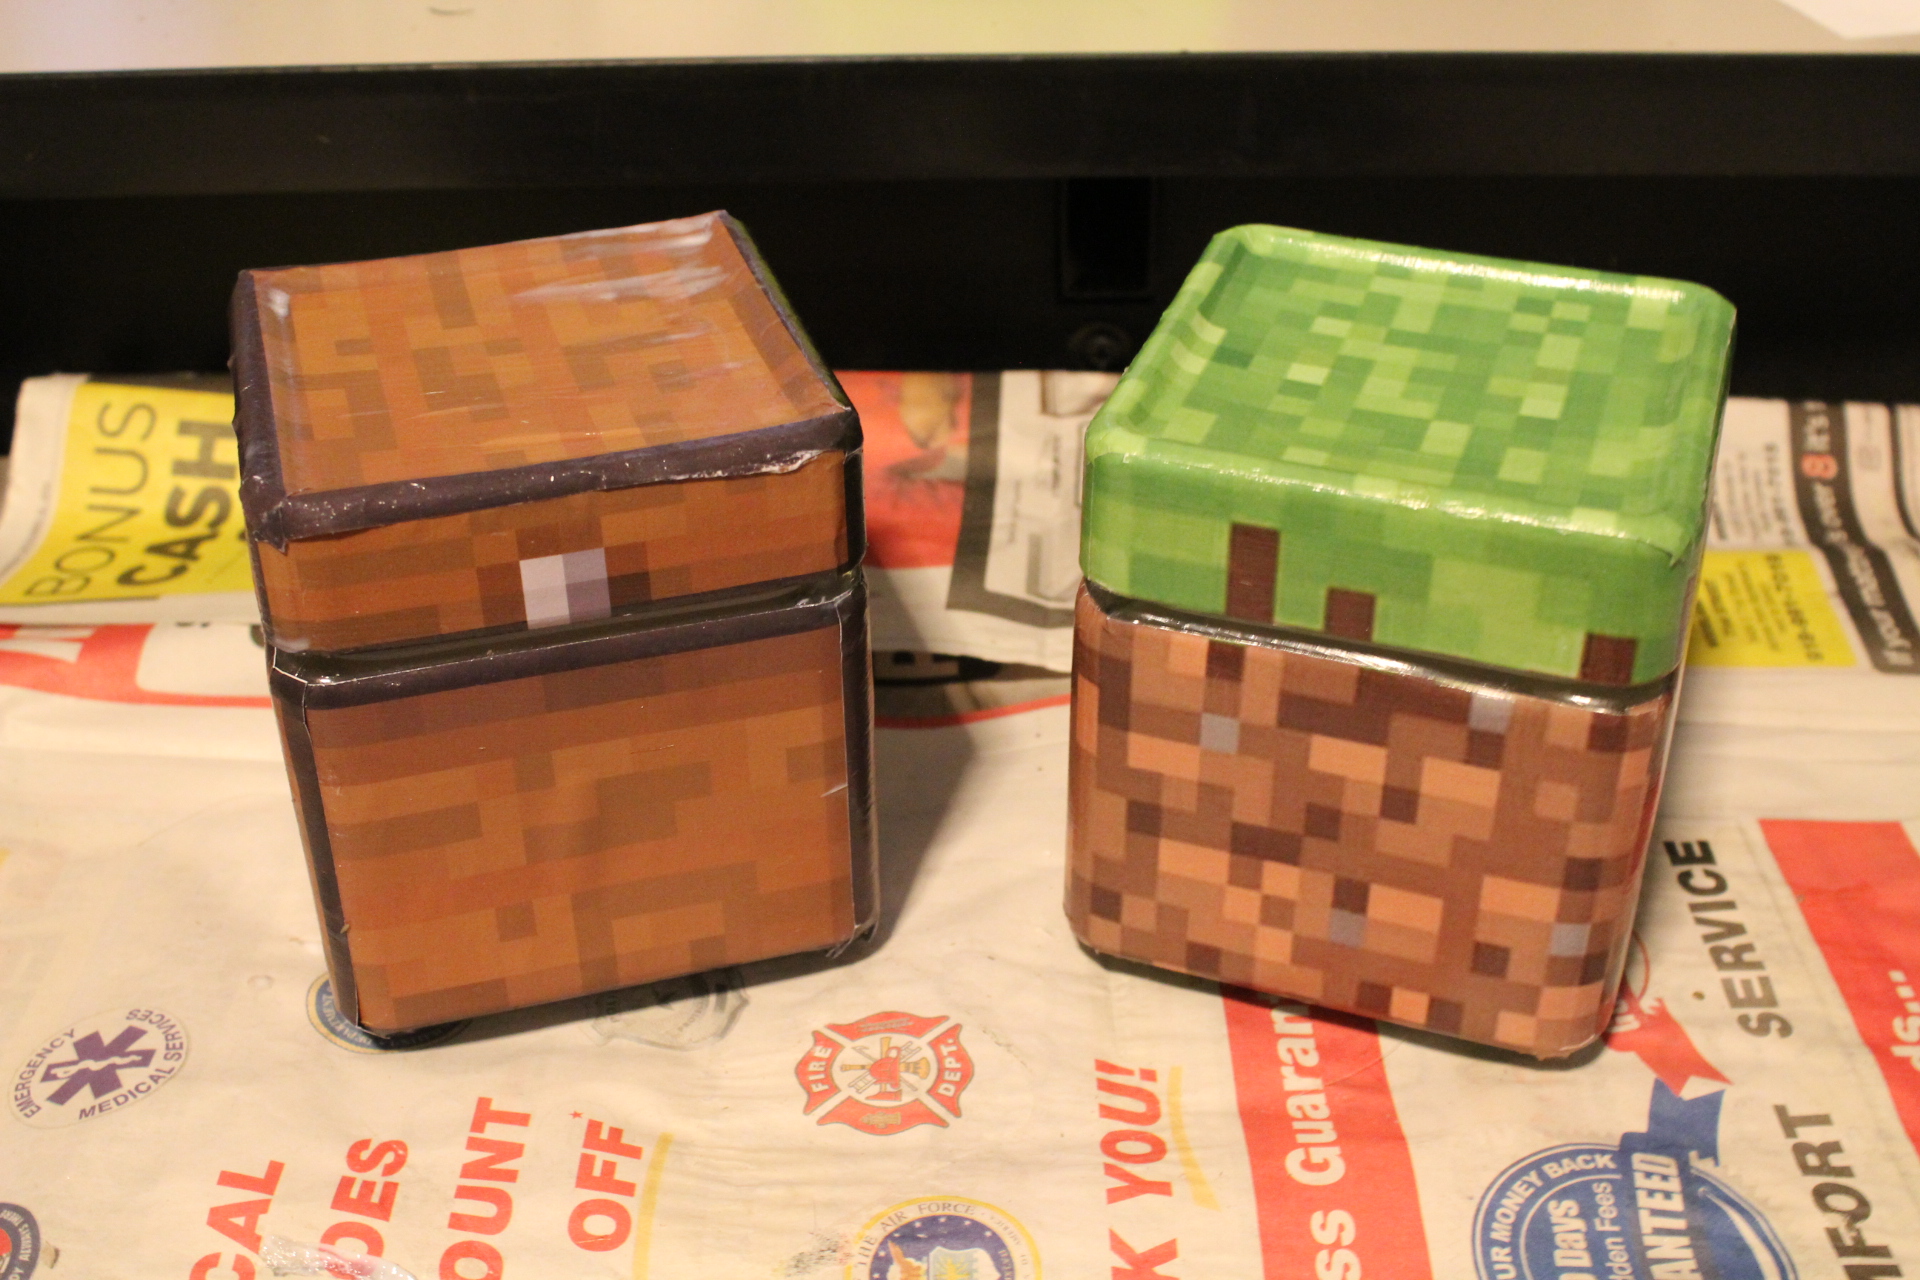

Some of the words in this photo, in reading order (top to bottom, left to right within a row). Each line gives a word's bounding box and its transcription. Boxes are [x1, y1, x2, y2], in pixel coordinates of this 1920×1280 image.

[24, 402, 157, 597] BONUS
[117, 418, 238, 586] CASH
[1662, 840, 1794, 1039] SERVICE
[14, 1028, 76, 1119] EMERGENCY
[126, 1008, 184, 1062] SERVICES
[808, 1045, 832, 1092] FIRE
[937, 1038, 962, 1098] DEPT.
[78, 1066, 175, 1120] MEDICAL
[1094, 1059, 1174, 1205] YOU!
[1264, 1003, 1347, 1186] Guaran
[438, 1096, 531, 1280] OUNT
[880, 1210, 909, 1233] AIR
[917, 1202, 975, 1218] FORCE
[1489, 1170, 1545, 1243] MONEY
[1542, 1153, 1617, 1178] BACK
[1592, 1181, 1622, 1233] Fees
